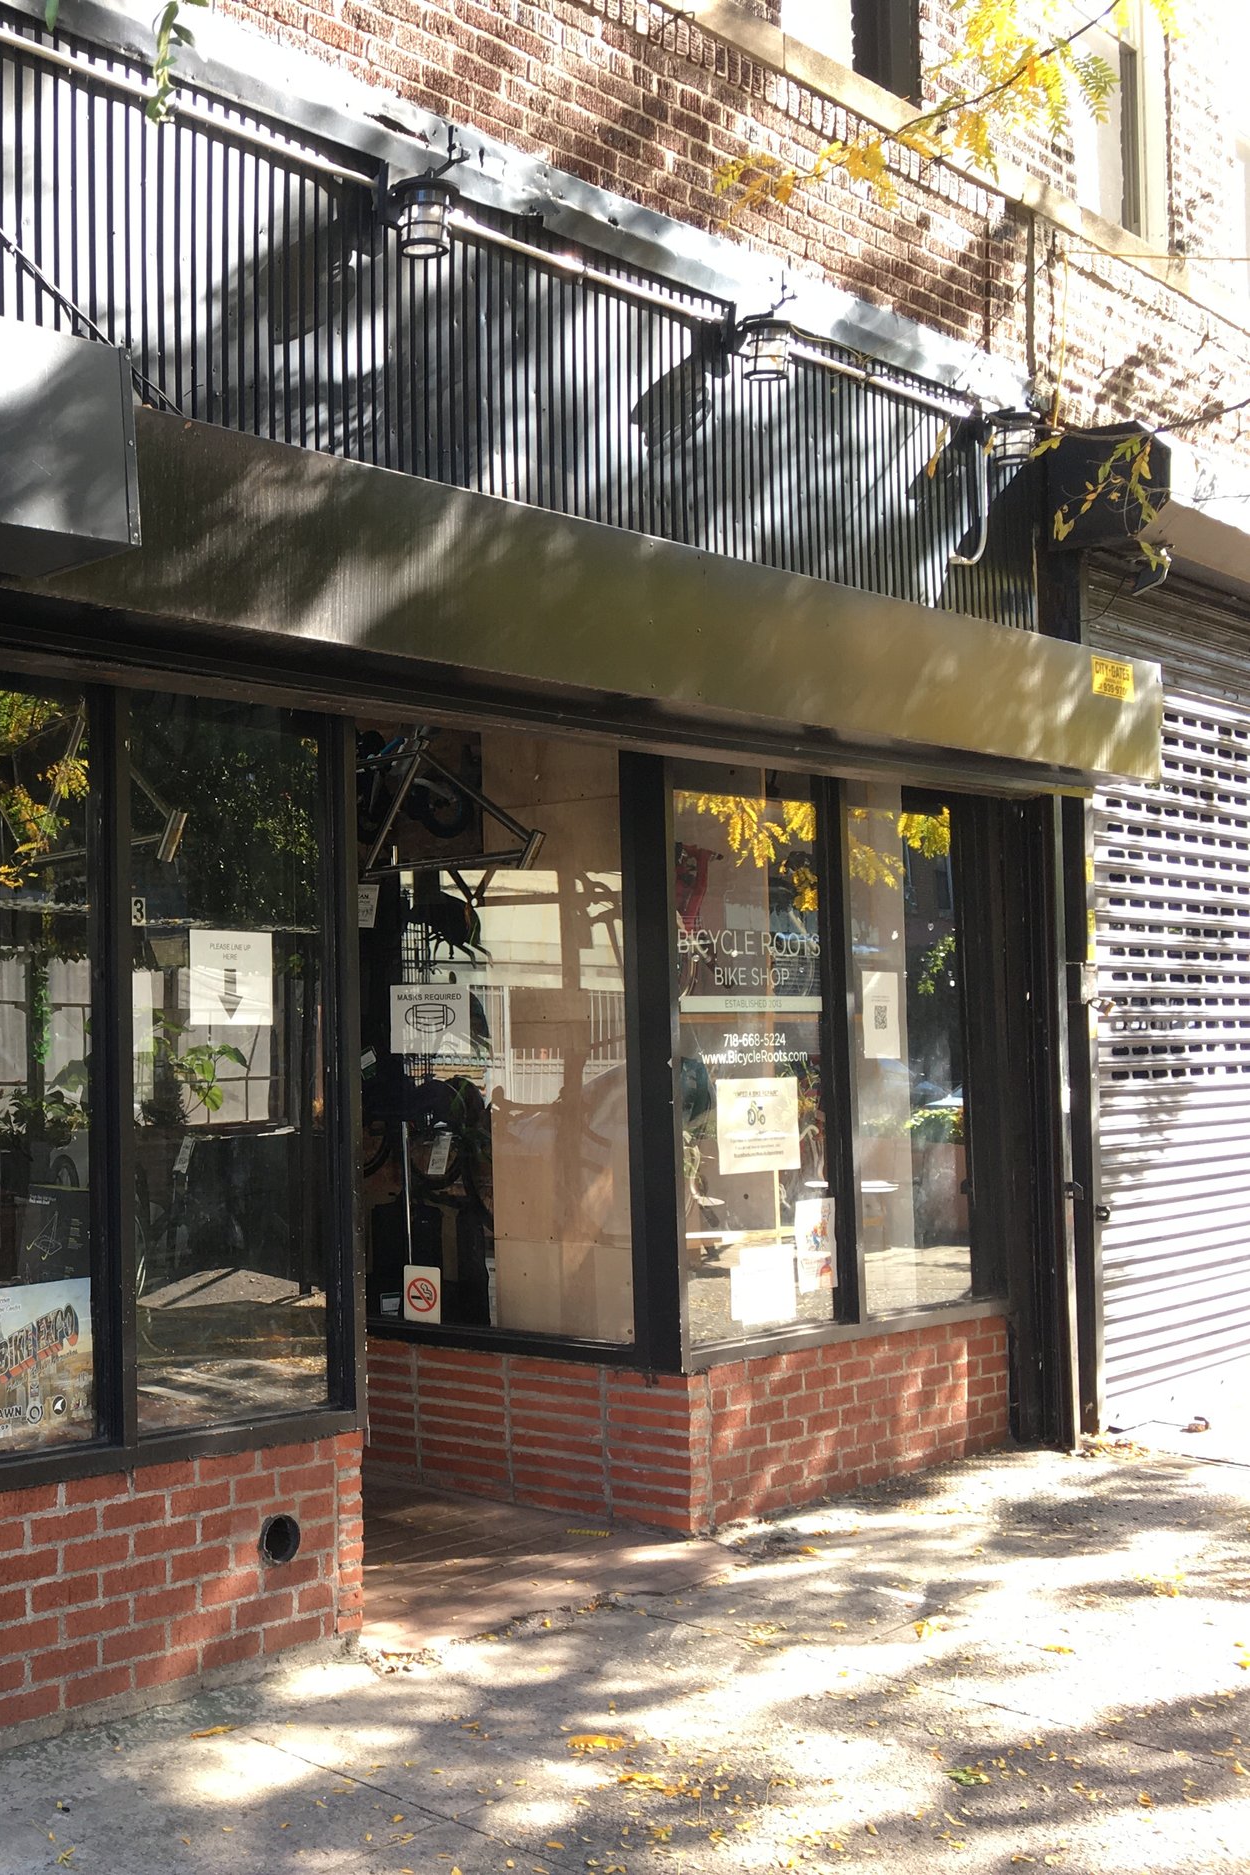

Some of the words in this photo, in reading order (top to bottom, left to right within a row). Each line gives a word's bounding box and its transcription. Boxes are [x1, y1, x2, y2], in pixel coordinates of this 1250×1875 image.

[133, 899, 144, 923] 3
[677, 928, 755, 956] BICYCLE
[761, 932, 821, 957] ROOTS
[714, 967, 747, 986] BIKE
[751, 967, 790, 986] SHOP
[725, 999, 768, 1009] ESTABLISHED
[769, 999, 782, 1009] 2013
[723, 1033, 786, 1047] 718-668-5224
[701, 1051, 808, 1066] www.BicycleRoots.com
[35, 1303, 80, 1360] EXPO
